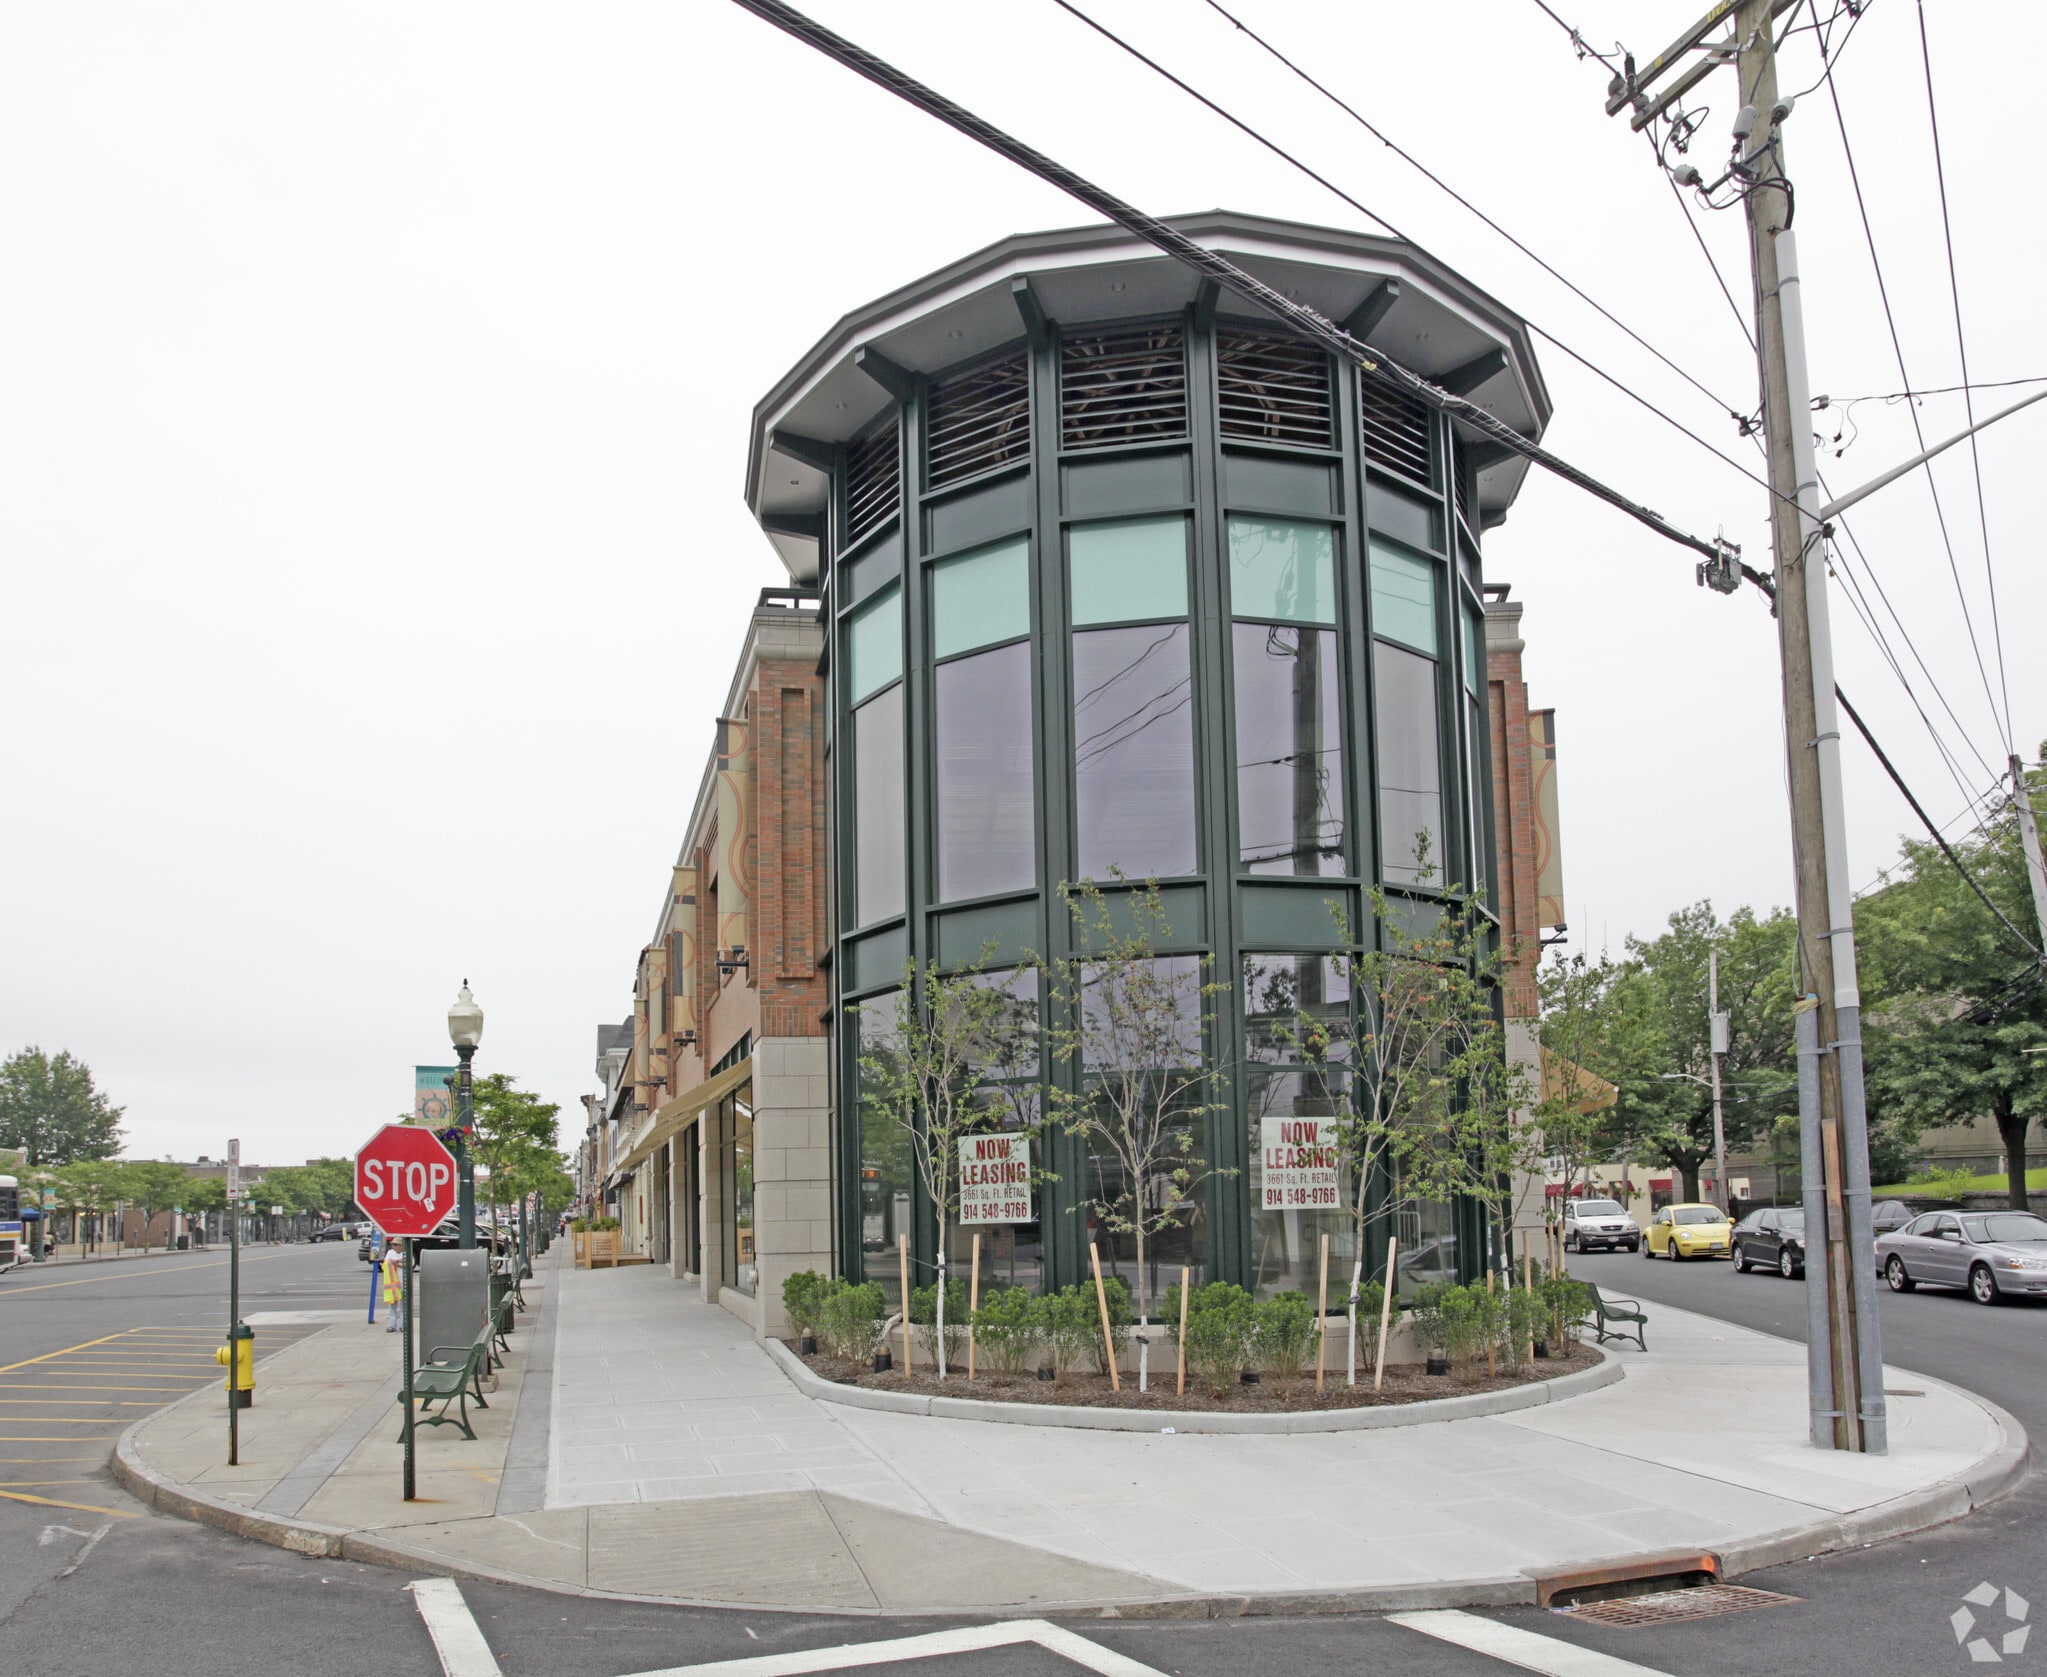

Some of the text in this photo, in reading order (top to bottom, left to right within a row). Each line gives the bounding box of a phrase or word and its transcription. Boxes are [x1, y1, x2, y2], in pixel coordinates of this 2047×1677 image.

[1281, 1122, 1318, 1143] NOW
[976, 1138, 1010, 1160] NOW
[1266, 1147, 1335, 1169] LEASING
[363, 1159, 449, 1201] STOP
[963, 1162, 1026, 1185] LEASING
[1266, 1173, 1283, 1184] 3661
[1312, 1172, 1335, 1184] RETAIL
[963, 1189, 978, 1200] 3661
[1004, 1187, 1027, 1198] RETAIL
[1266, 1187, 1336, 1205] 914 548-9766
[963, 1202, 1027, 1219] 914 548-9766
